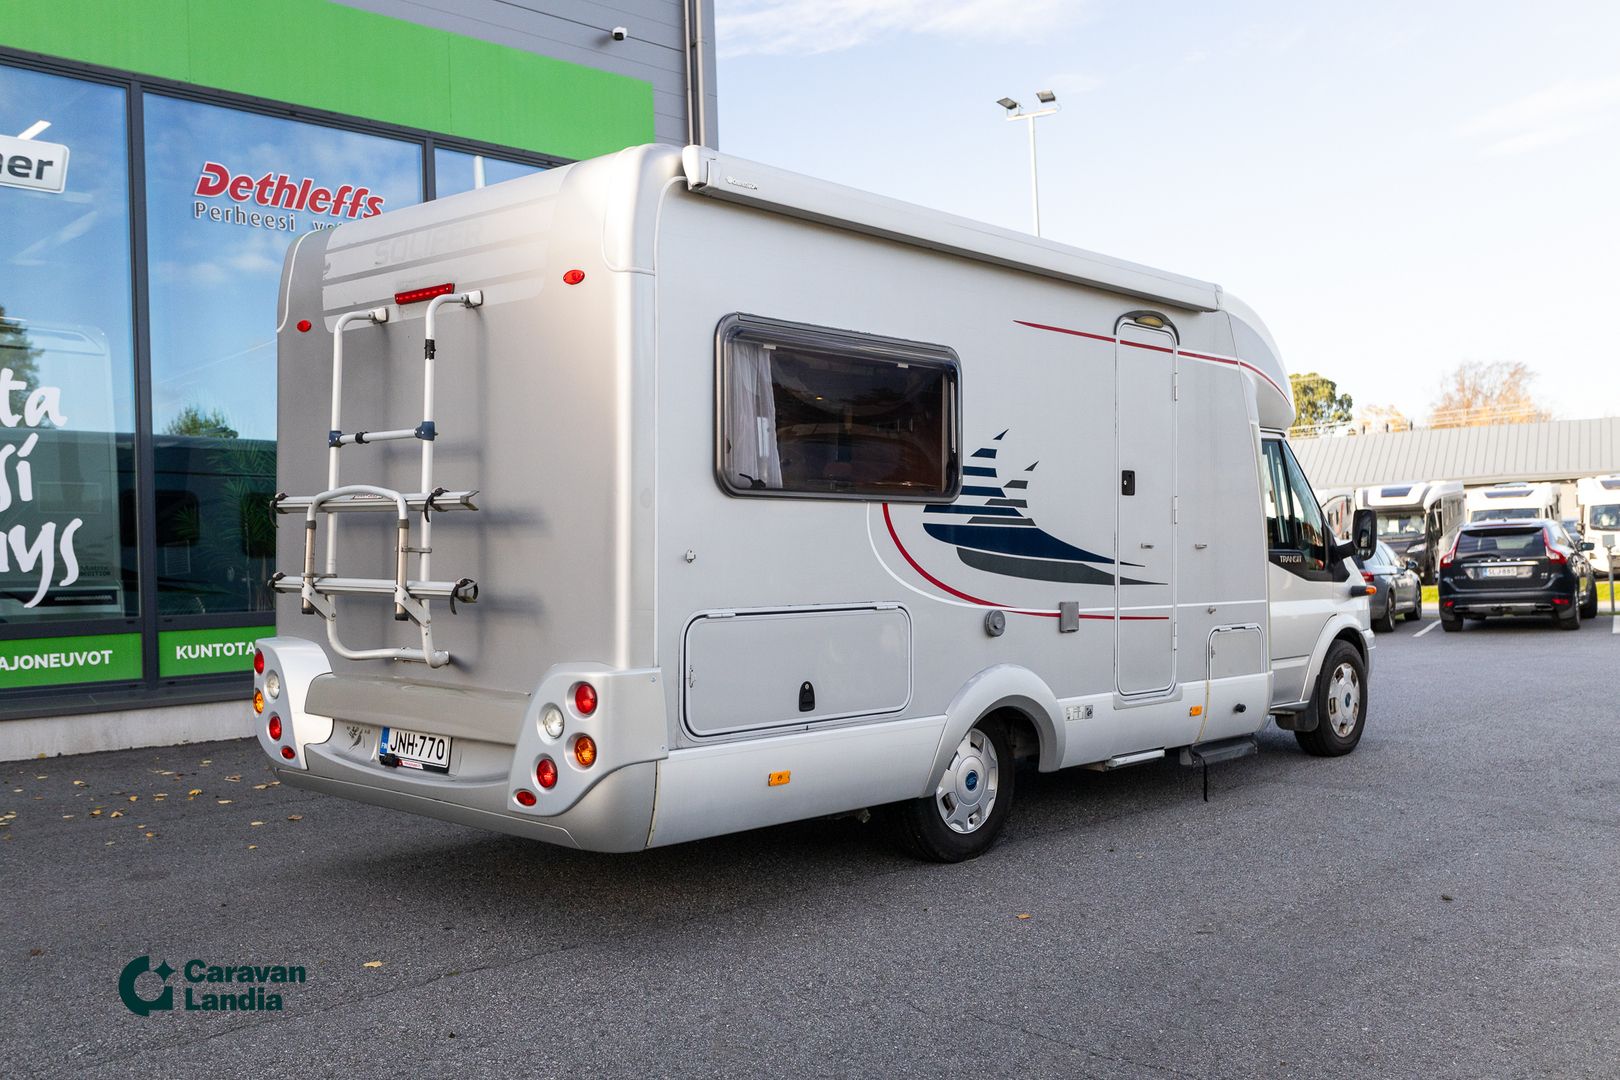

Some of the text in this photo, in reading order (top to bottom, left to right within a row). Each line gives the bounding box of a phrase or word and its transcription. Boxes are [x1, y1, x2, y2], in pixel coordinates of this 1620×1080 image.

[0, 153, 54, 180] er
[194, 162, 384, 219] Dethleffs
[195, 201, 296, 231] Perheesi
[0, 517, 83, 608] ys
[1280, 555, 1302, 564] TRANSIT
[0, 650, 113, 671] AJONEUVOT
[390, 731, 445, 760] JNH-770
